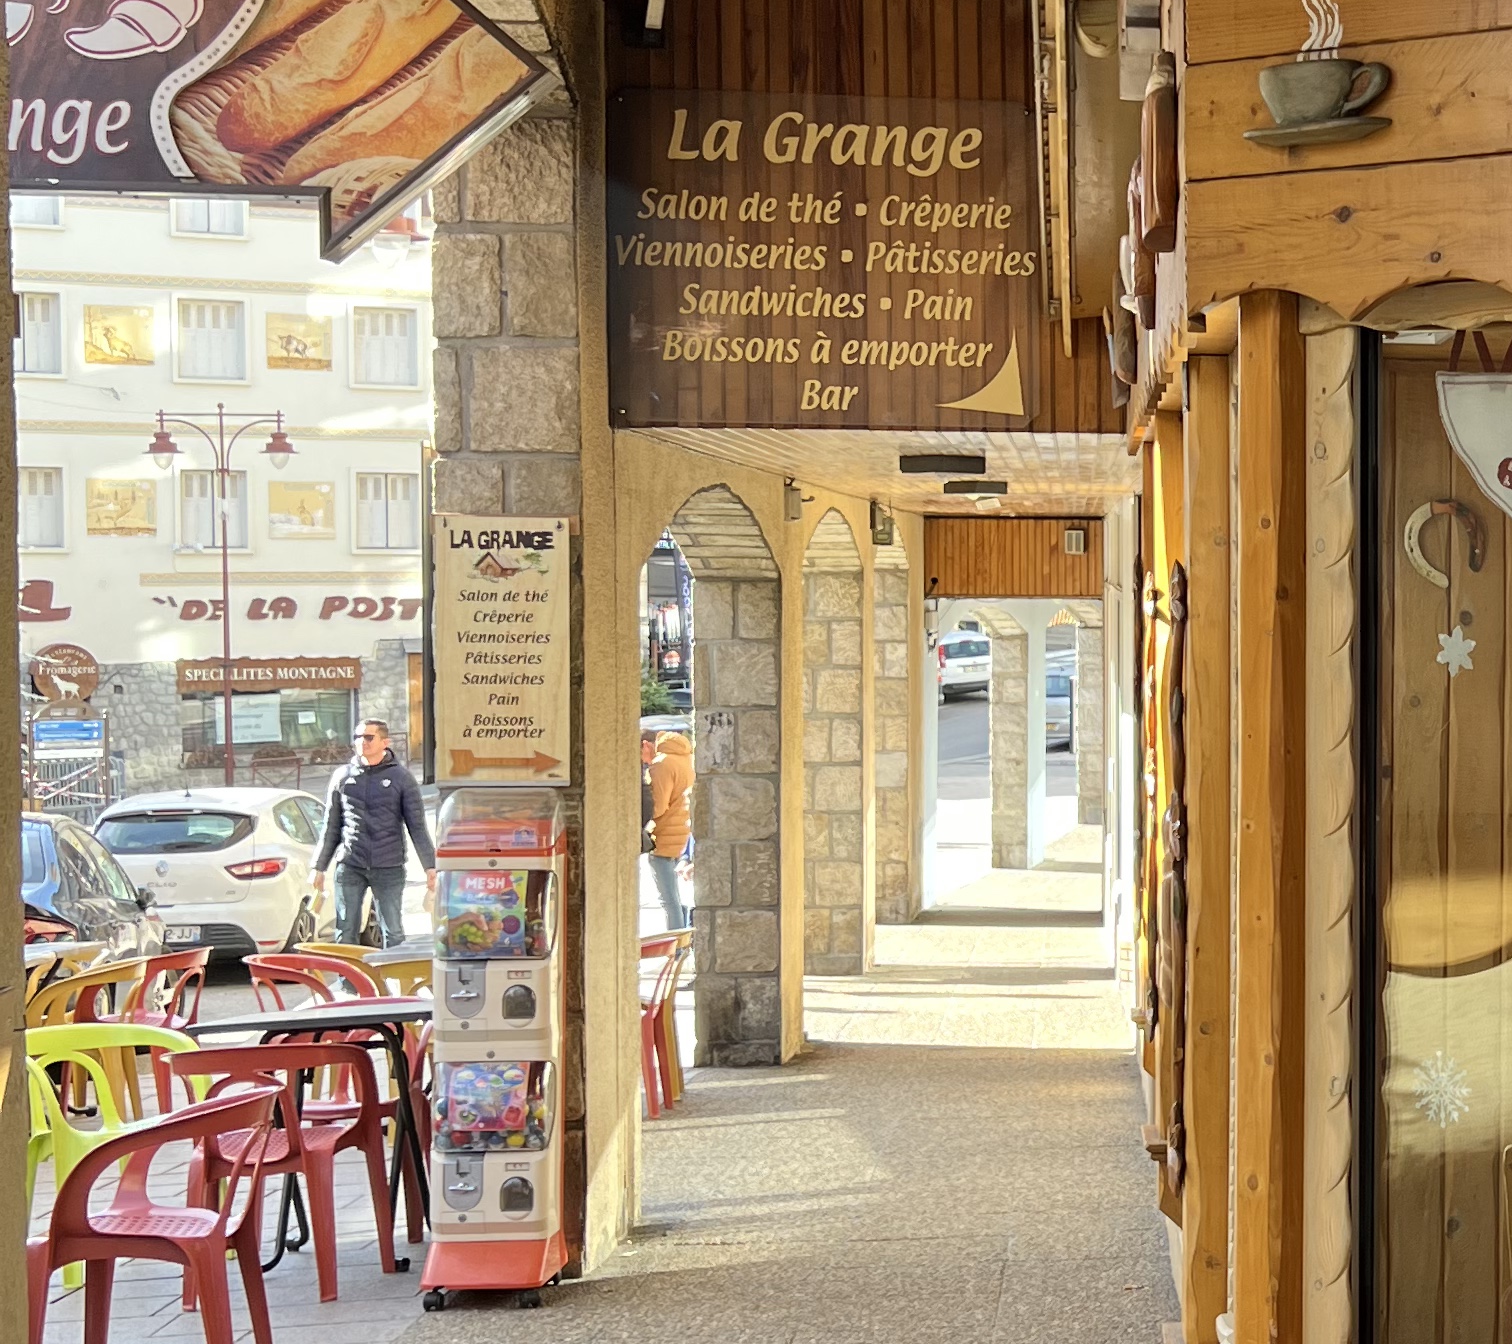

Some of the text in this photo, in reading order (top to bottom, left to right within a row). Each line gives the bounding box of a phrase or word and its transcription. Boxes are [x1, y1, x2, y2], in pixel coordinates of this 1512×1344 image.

[668, 108, 983, 176] La Grange
[637, 188, 1012, 232] Salon de thé Crêperie
[614, 233, 1037, 276] Viennoiseries Pâtisseries
[679, 284, 974, 321] Sandwiches Pain
[663, 331, 993, 370] Boissons à emporter
[800, 379, 859, 411] Bar
[450, 529, 555, 550] LA GRANGE
[457, 589, 549, 603] Salon de thé
[247, 596, 298, 621] LA
[473, 609, 534, 625] Crêperie
[457, 631, 551, 644] Viennoiseries
[465, 652, 543, 665] Pâtisseries
[185, 666, 355, 681] SPECILITES MONTAGNE
[461, 672, 545, 685] Sandwiches
[487, 693, 520, 706] Pain
[473, 714, 534, 727] Boissons
[463, 725, 545, 739] à emporter
[465, 877, 506, 889] MESH
